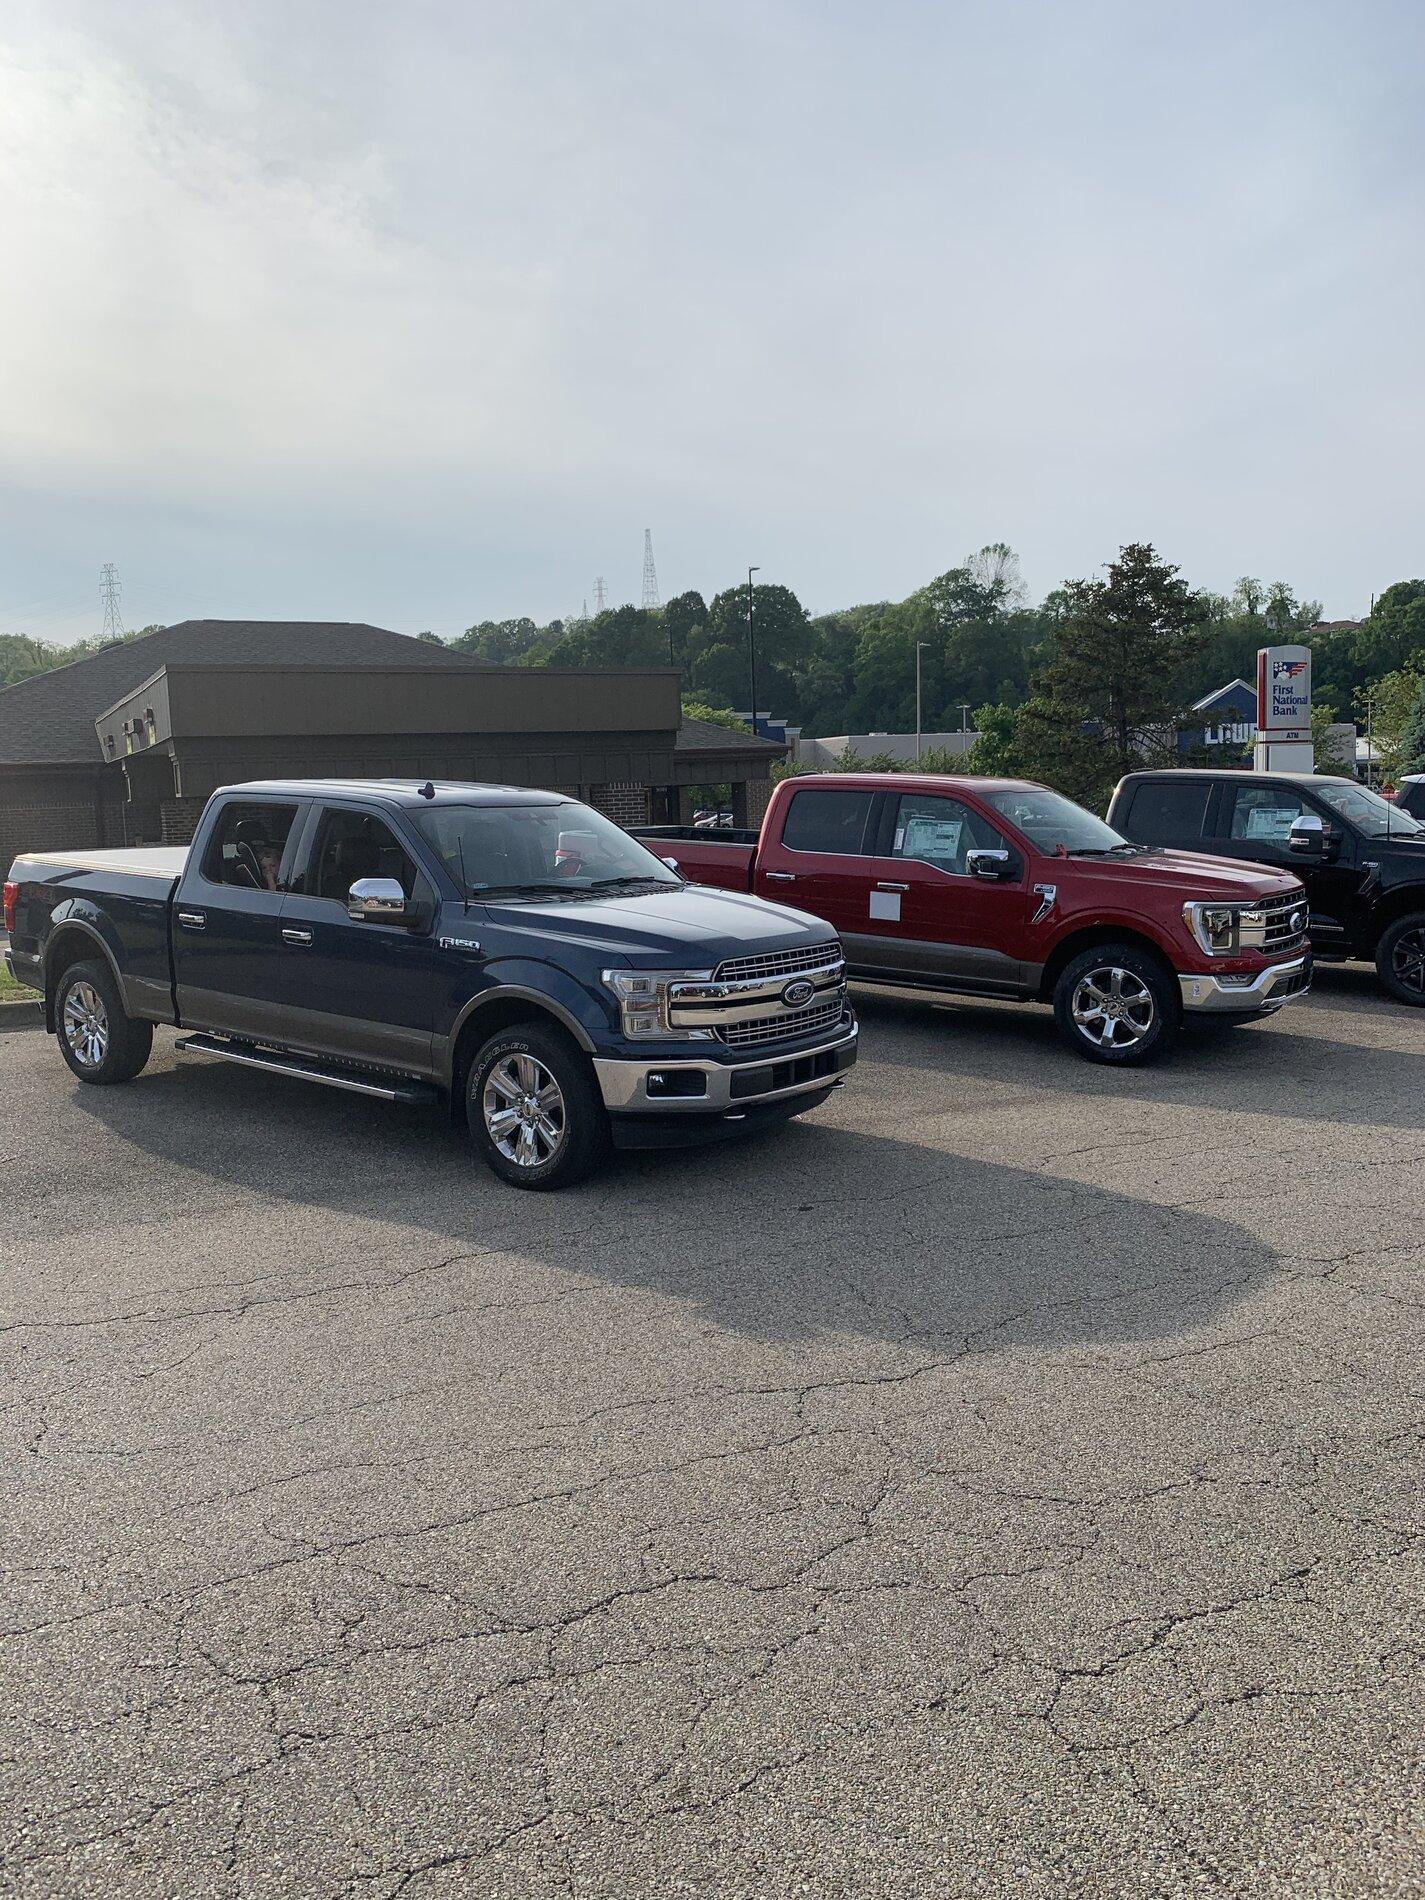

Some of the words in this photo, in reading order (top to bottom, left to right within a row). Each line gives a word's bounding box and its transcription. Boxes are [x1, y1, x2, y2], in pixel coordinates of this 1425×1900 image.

[1273, 685, 1293, 695] First
[1273, 695, 1308, 705] National
[1273, 706, 1298, 716] Bank
[470, 1042, 529, 1100] WRANGLER
